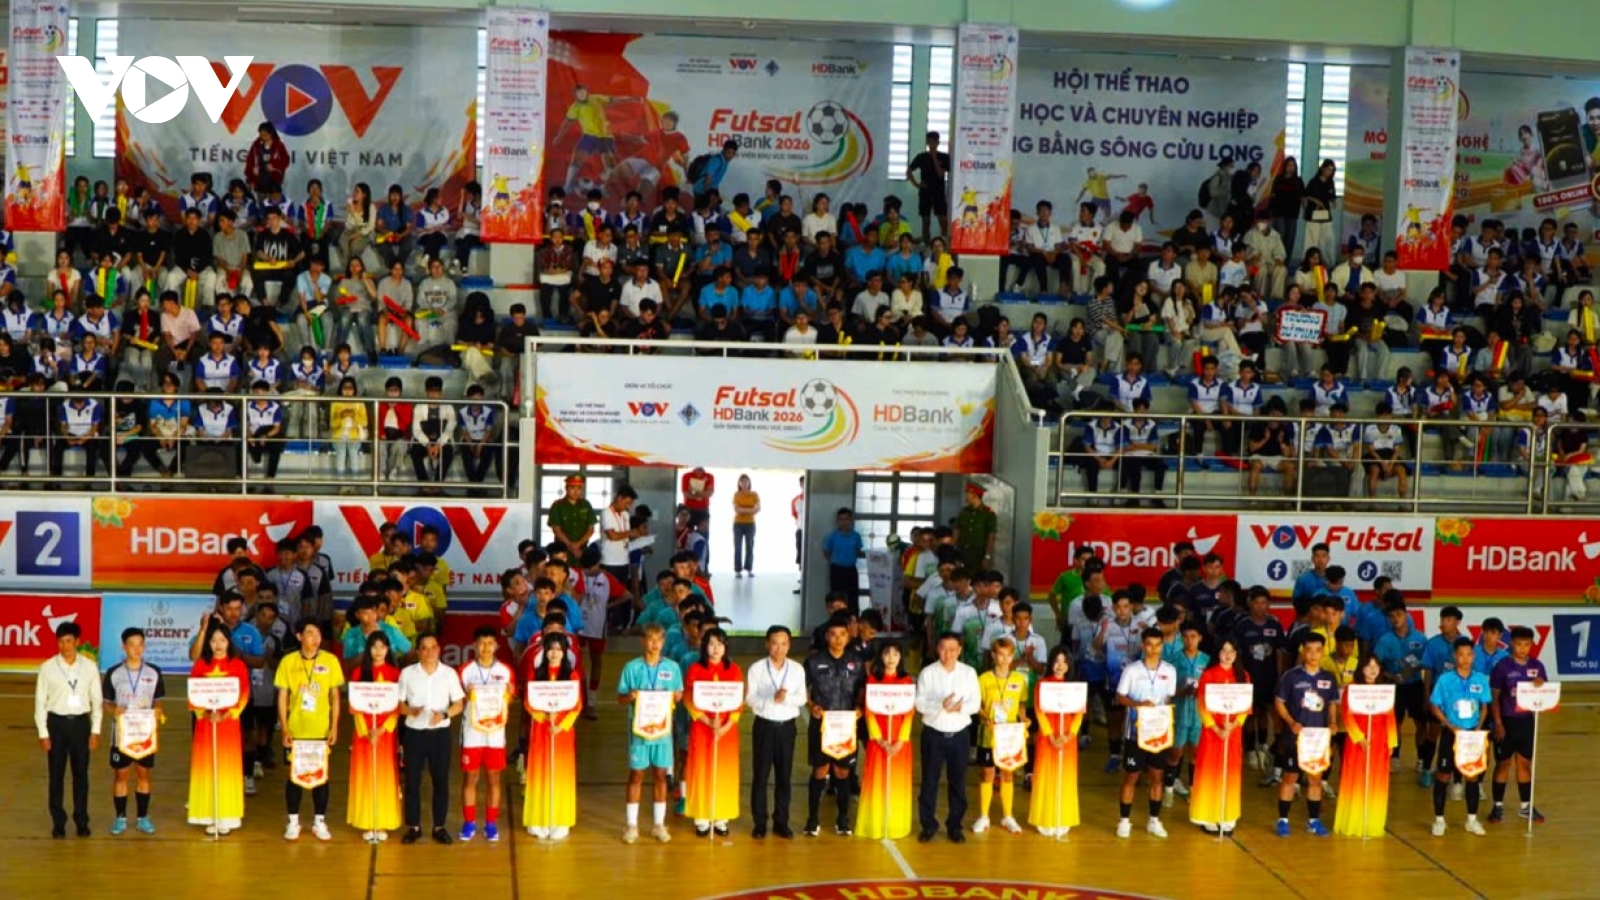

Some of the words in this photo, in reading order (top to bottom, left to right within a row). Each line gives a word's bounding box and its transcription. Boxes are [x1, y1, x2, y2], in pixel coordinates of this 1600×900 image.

[812, 63, 857, 75] HDBank
[1053, 68, 1089, 97] HỘI
[1094, 67, 1131, 92] THỂ
[1135, 75, 1190, 95] THAO
[204, 63, 403, 140] VOV
[710, 107, 801, 134] Futsal
[1020, 104, 1065, 126] HỌC
[1071, 101, 1097, 124] VÀ
[1102, 104, 1182, 128] CHUYÊN
[1187, 108, 1259, 135] NGHIỆP
[190, 143, 249, 166] TIẾNG
[303, 148, 350, 167] VIỆT
[360, 151, 404, 167] NAM
[709, 132, 771, 150] HDBank
[773, 137, 810, 151] 2026
[1038, 130, 1096, 156] BẰNG
[1099, 136, 1158, 159] SÔNG
[1162, 137, 1204, 161] CỬU
[1208, 143, 1265, 164] LONG
[627, 402, 670, 417] VOV
[714, 386, 797, 408] Futsal
[713, 408, 770, 421] HDBank
[773, 411, 804, 422] 2026
[873, 404, 954, 424] HDBank
[34, 521, 63, 566] 2
[130, 526, 260, 556] HDBank
[338, 505, 508, 564] VOV
[1250, 525, 1320, 555] VOV
[1325, 526, 1424, 556] Futsal
[1467, 545, 1578, 572] HDBank
[145, 628, 190, 638] CKENT
